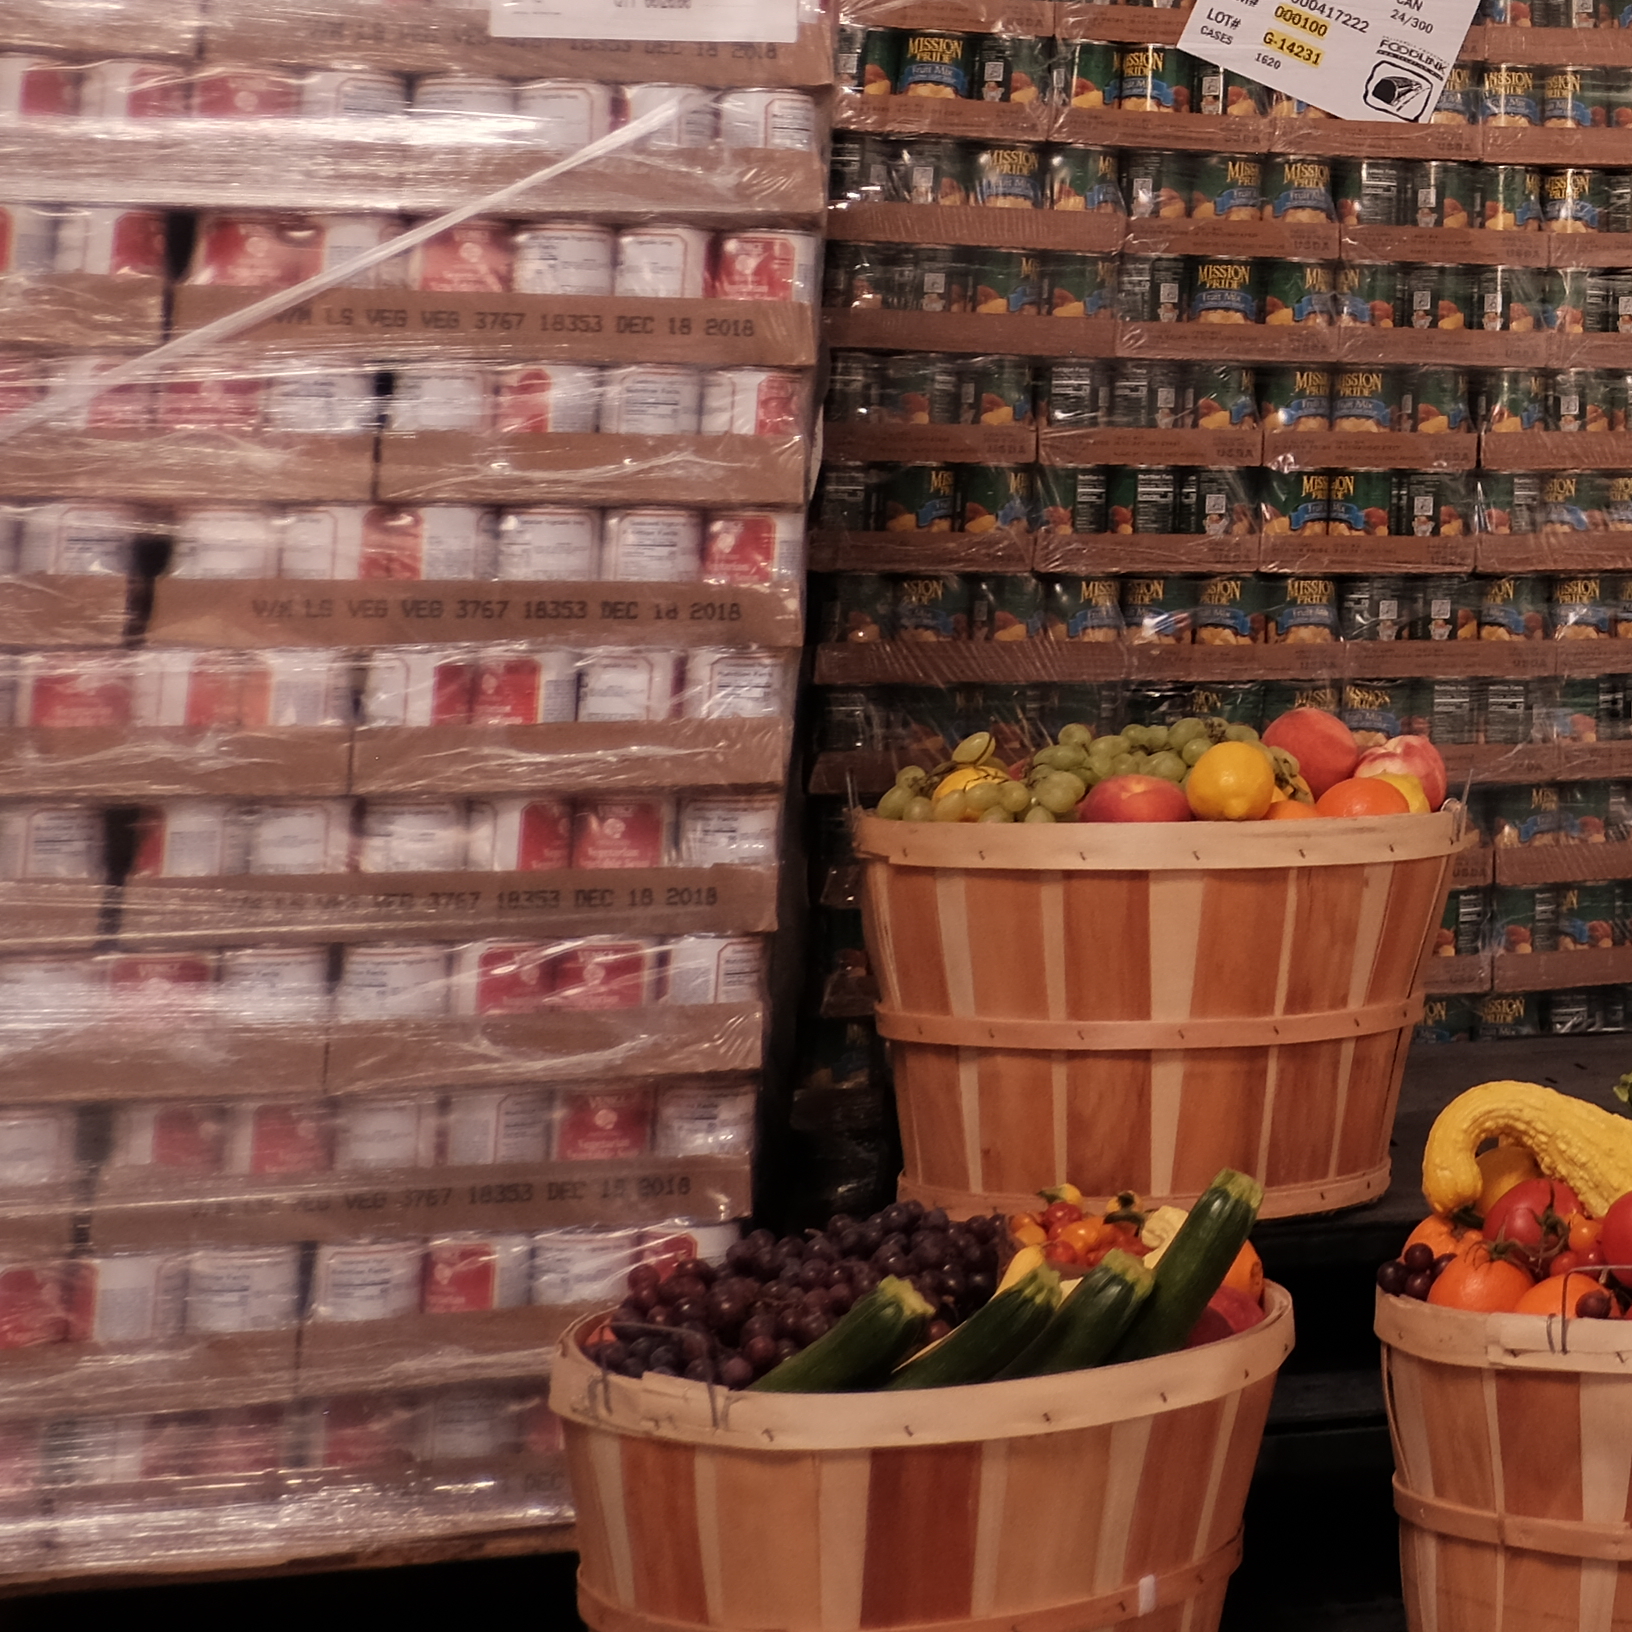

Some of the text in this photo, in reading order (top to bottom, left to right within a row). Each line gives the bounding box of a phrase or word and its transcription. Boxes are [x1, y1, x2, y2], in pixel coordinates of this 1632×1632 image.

[1274, 5, 1329, 38] 000100
[1390, 9, 1434, 35] 24/300
[908, 37, 964, 58] MISSION
[1200, 25, 1281, 70] CASES 1620
[1206, 7, 1321, 66] LOT# G-14231
[917, 52, 951, 63] PRIDE
[1379, 38, 1447, 73] FOODLINK
[1198, 265, 1250, 285] MISSION
[1206, 277, 1242, 290] PRIDE
[421, 310, 459, 329] VEG
[475, 312, 524, 329] 3767
[540, 314, 601, 332] 18353
[617, 316, 653, 334] DEC
[669, 317, 691, 334] 18
[706, 318, 755, 337] 2018
[456, 600, 507, 619] 3767
[525, 602, 587, 619] 18353
[602, 603, 638, 619] DEC
[690, 604, 741, 621] 2018
[498, 890, 560, 909] 18353
[575, 889, 614, 907] DEC
[629, 888, 654, 906] 18
[665, 888, 718, 906] 2018
